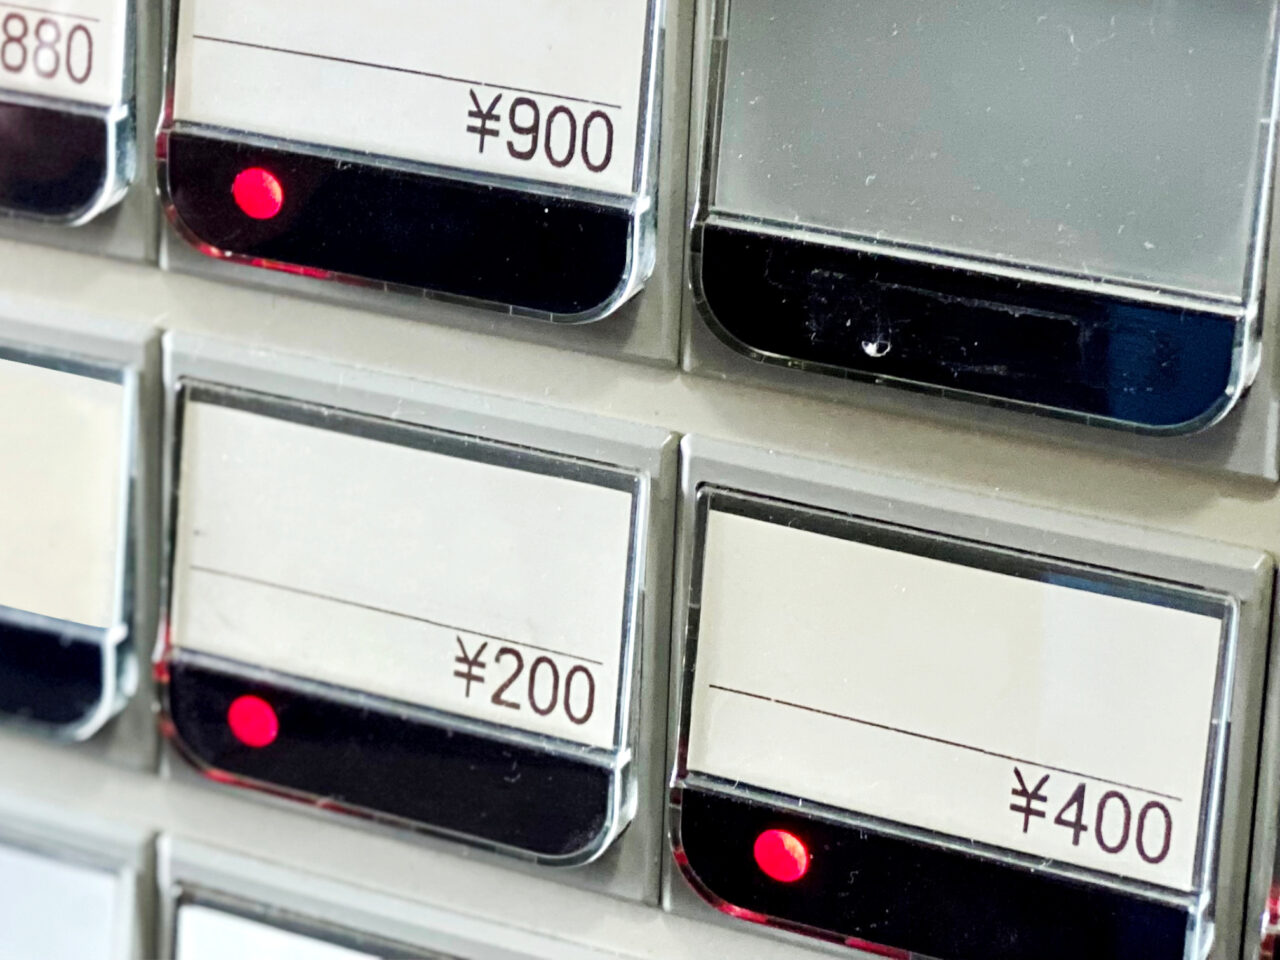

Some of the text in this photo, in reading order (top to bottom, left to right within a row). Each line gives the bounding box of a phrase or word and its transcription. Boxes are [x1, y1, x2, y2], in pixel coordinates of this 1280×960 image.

[466, 89, 615, 175] ¥900
[453, 636, 597, 726] ¥200
[1009, 766, 1173, 866] ¥400
